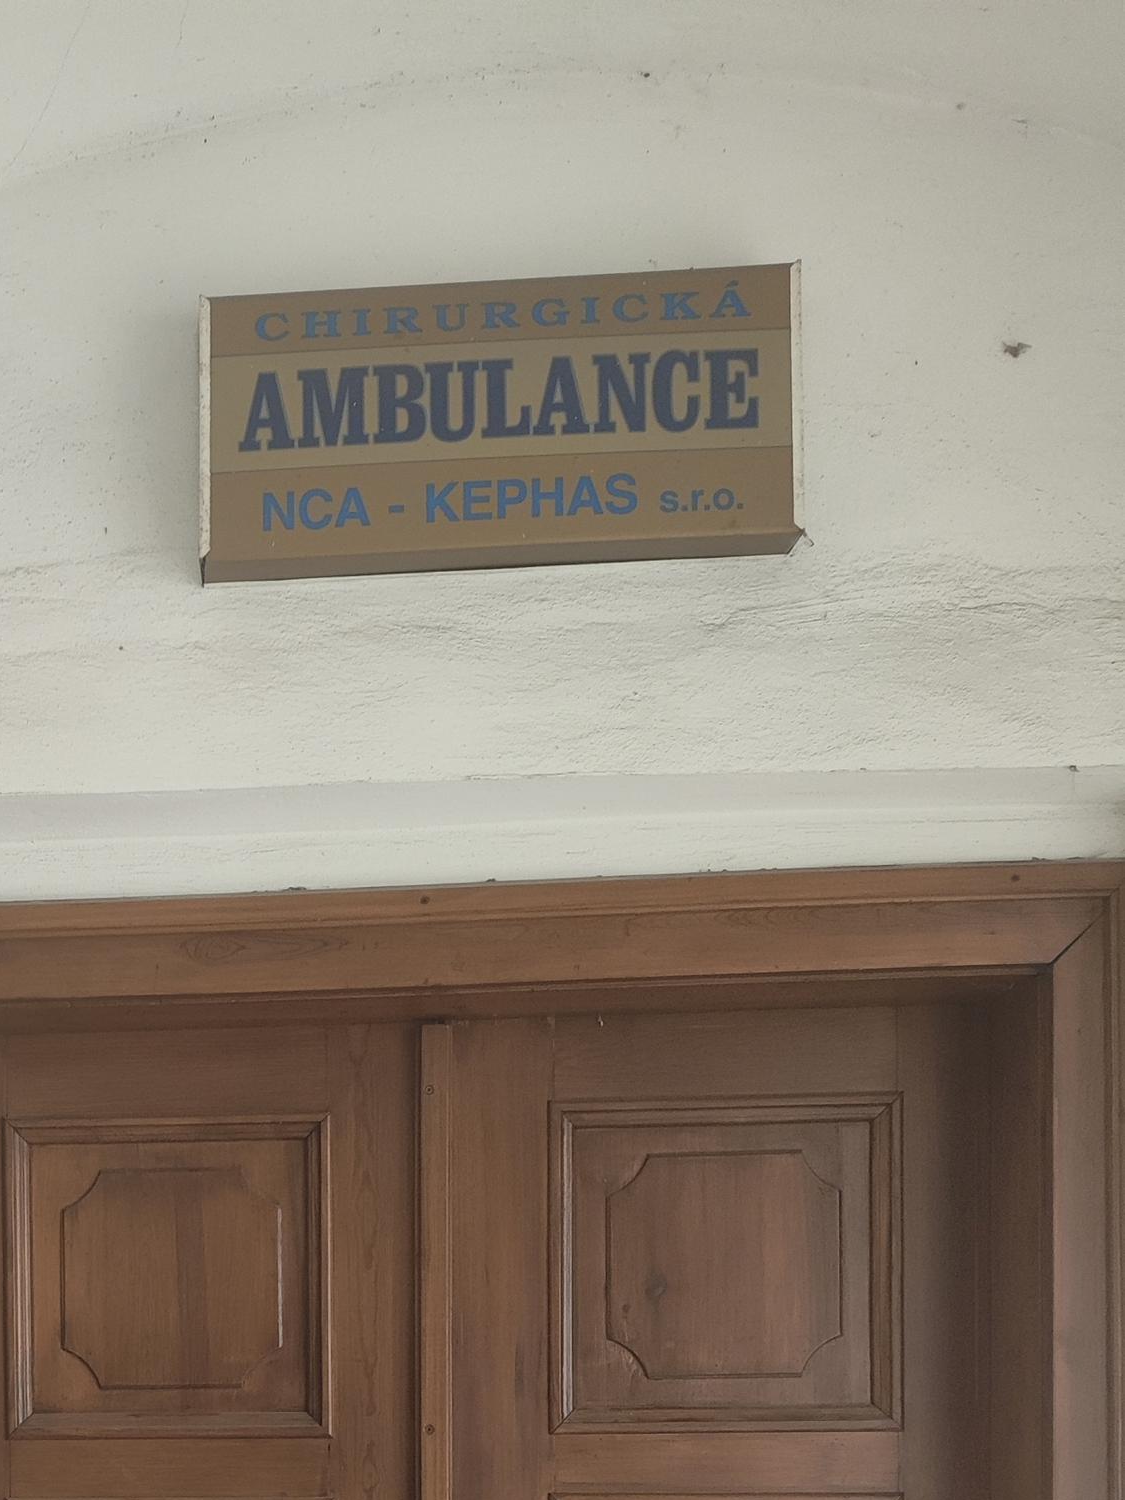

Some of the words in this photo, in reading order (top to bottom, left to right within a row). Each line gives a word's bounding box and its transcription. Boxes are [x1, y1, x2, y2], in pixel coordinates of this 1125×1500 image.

[253, 281, 752, 342] CHIRURGICKÁ
[237, 346, 761, 453] AMBULANCE
[262, 486, 371, 532] NCA
[425, 472, 639, 524] KEPHAS
[659, 485, 744, 514] s.r.o.
